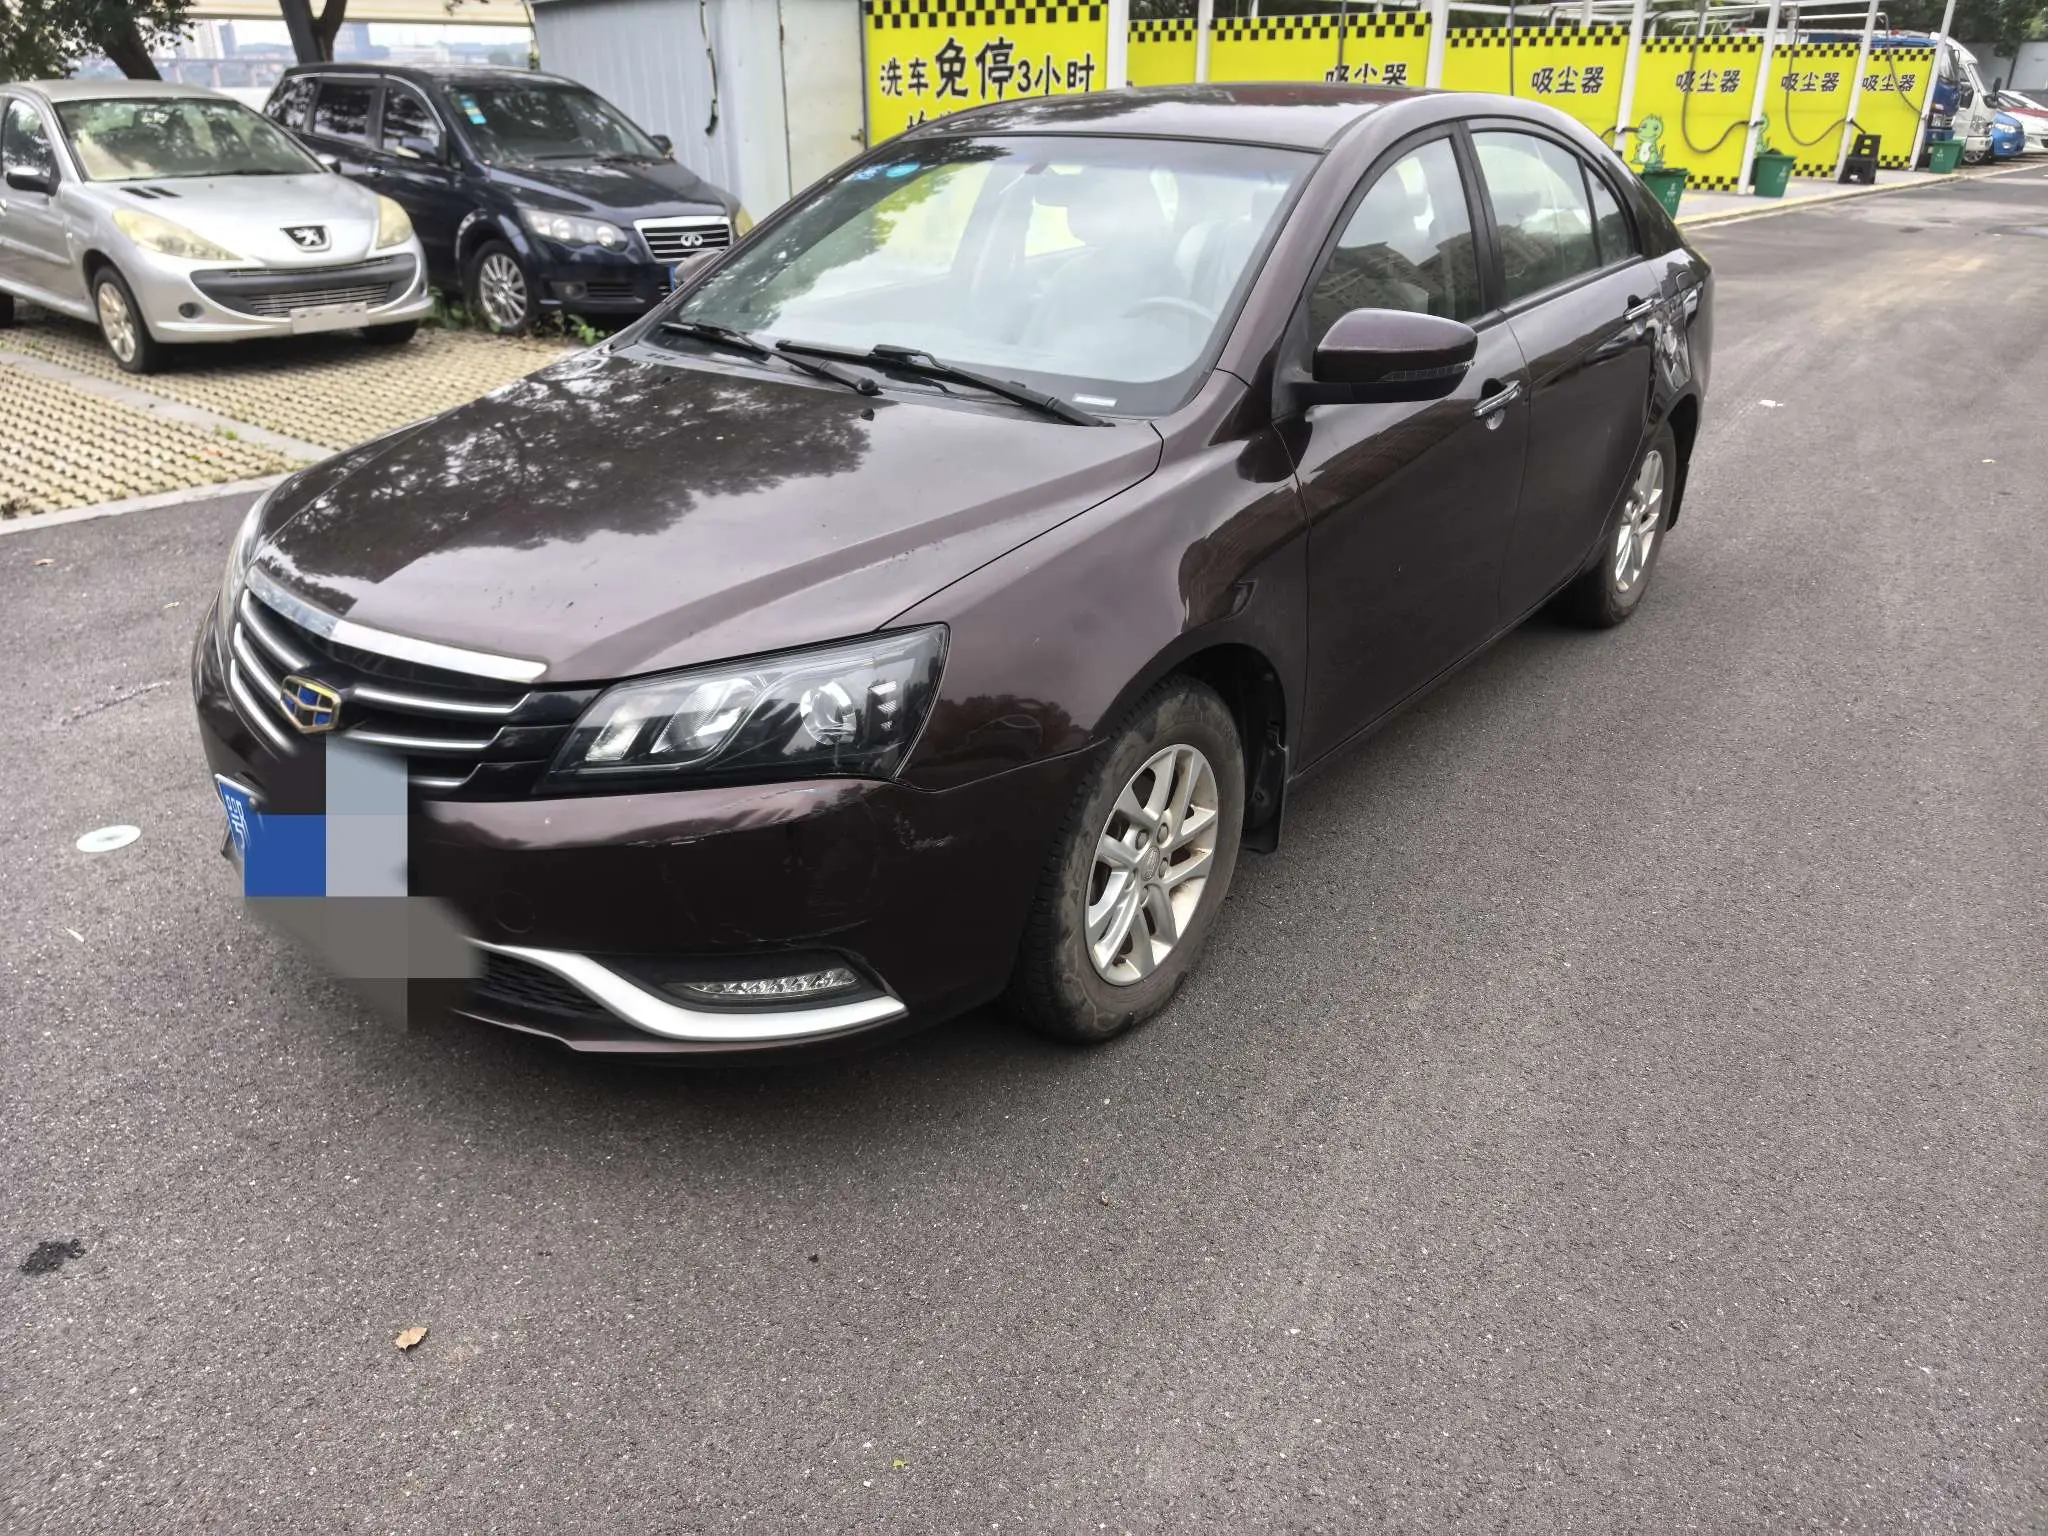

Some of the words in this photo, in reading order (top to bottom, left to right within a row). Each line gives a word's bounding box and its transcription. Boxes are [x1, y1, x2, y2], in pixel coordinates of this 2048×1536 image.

[880, 37, 1095, 99] 洗车免停3小时
[1531, 65, 1604, 94] 吸尘器
[1675, 69, 1741, 93] 吸尘器
[1781, 71, 1840, 92] 吸尘器
[1861, 73, 1916, 92] 吸尘器
